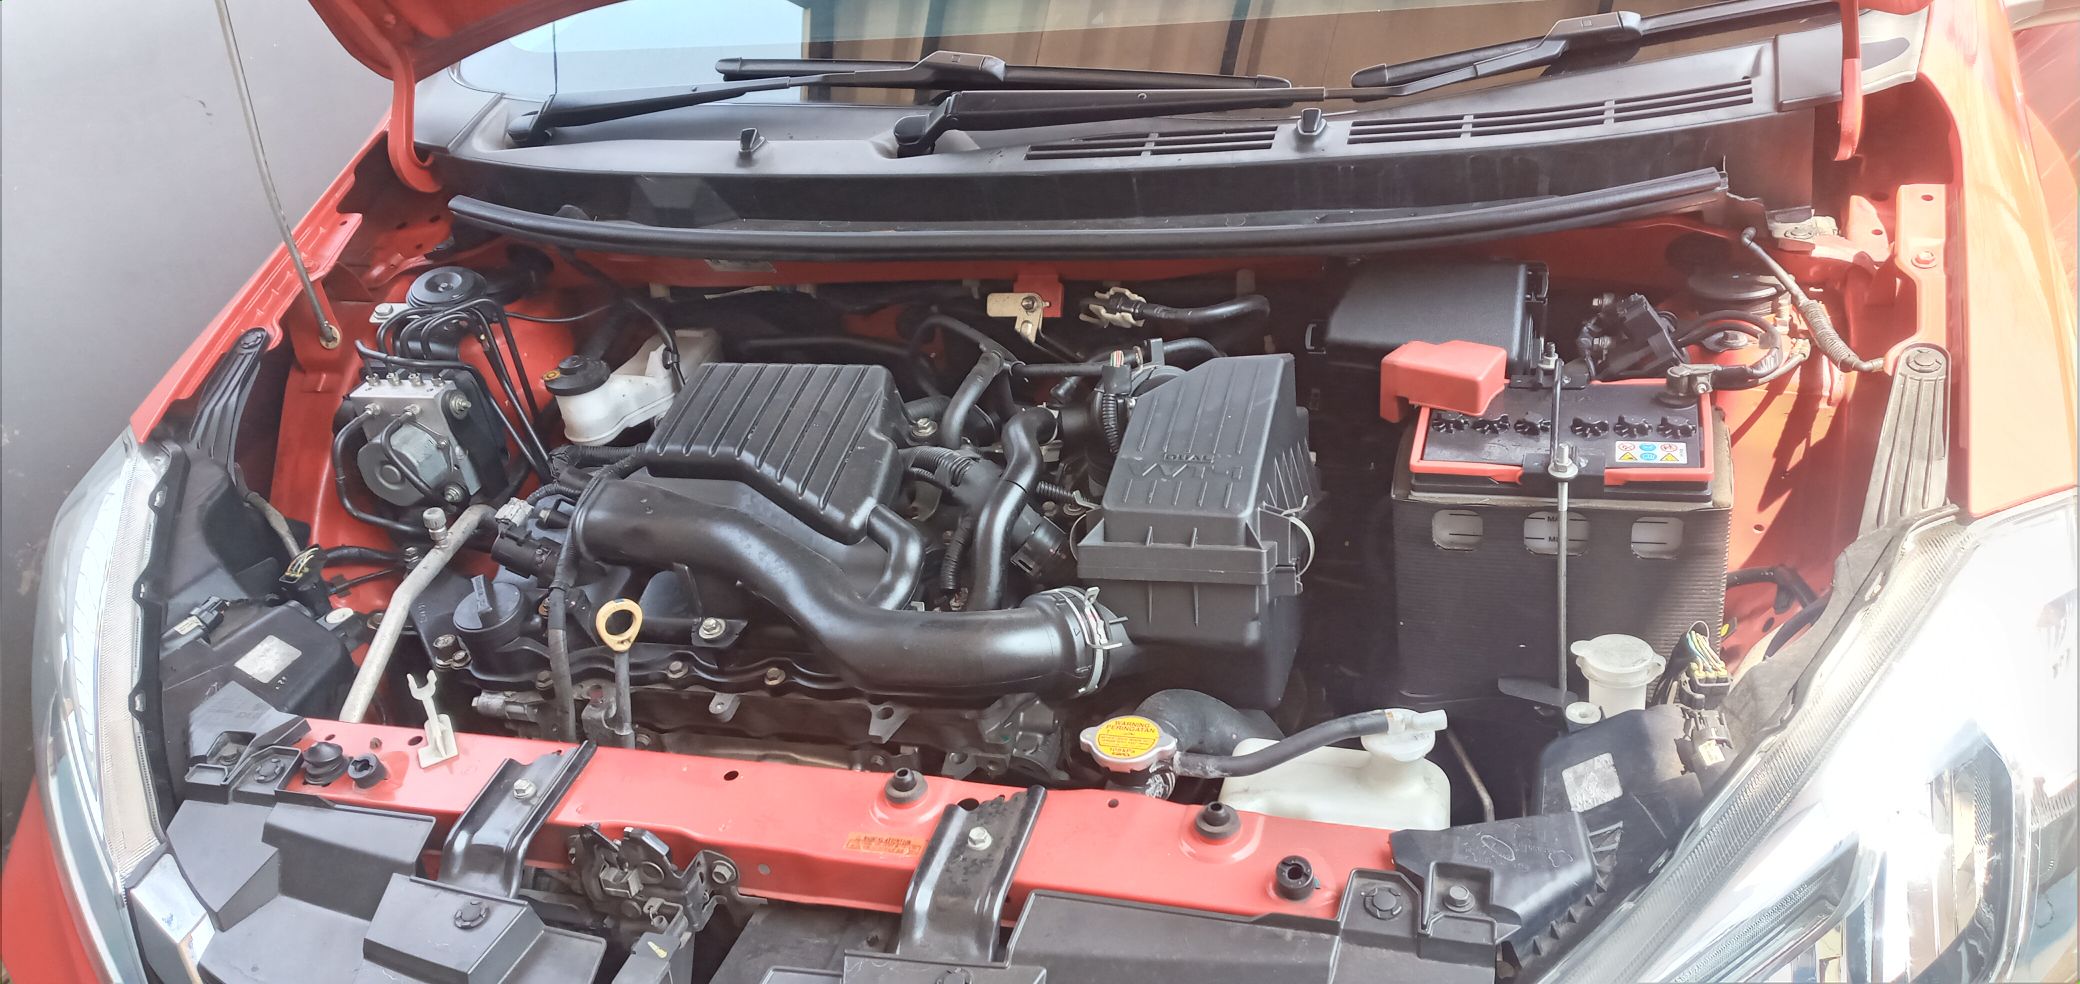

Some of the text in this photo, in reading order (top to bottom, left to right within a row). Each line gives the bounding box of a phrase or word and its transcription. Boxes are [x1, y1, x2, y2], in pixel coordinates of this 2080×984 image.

[1163, 453, 1213, 463] DUAL
[1106, 724, 1156, 734] PERINGATAN
[1115, 720, 1151, 729] WARNING
